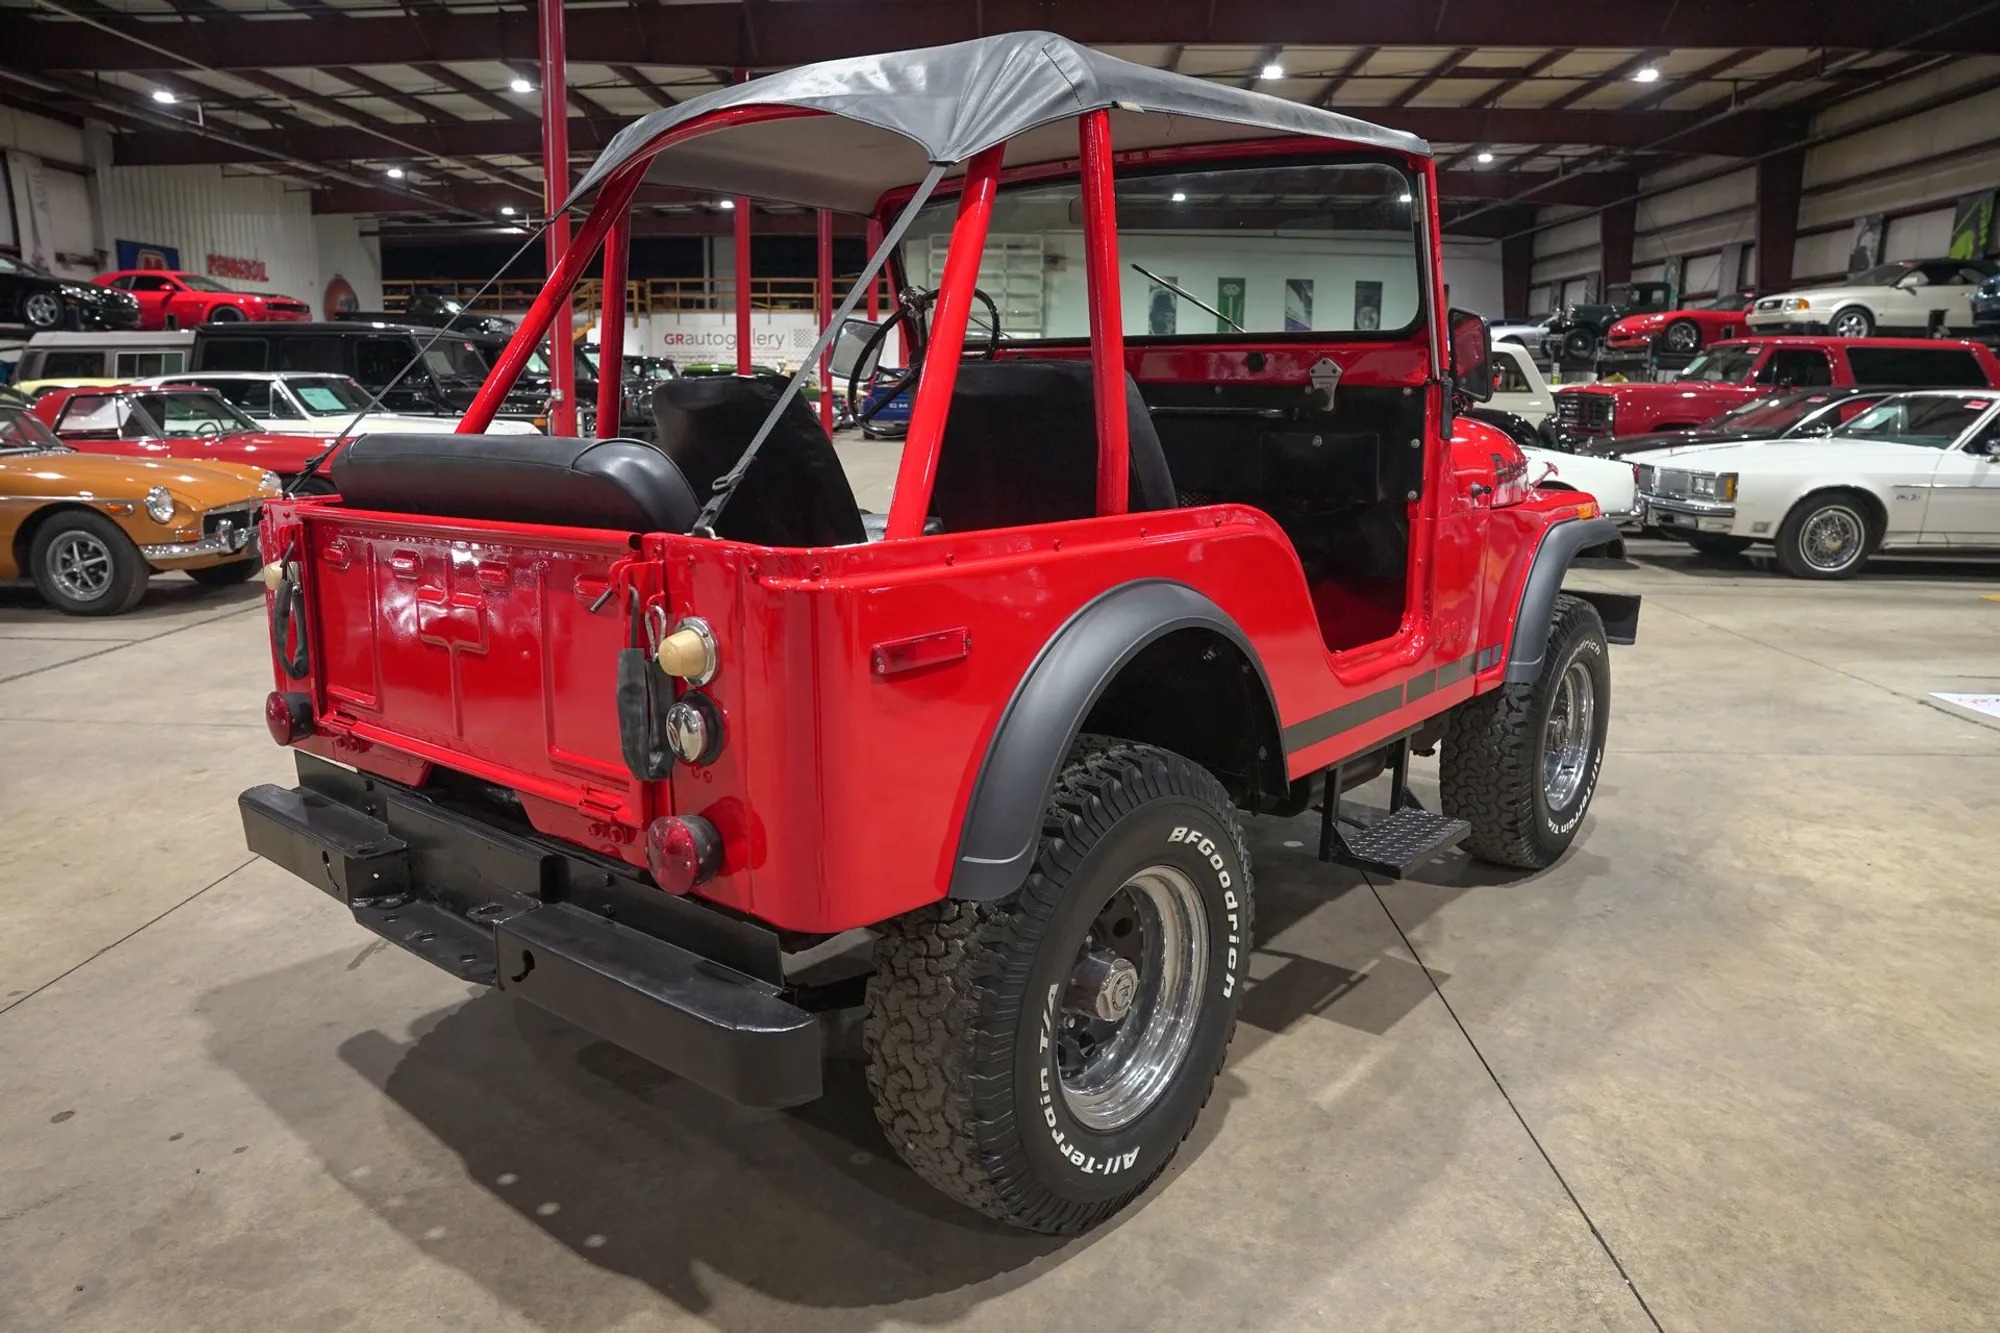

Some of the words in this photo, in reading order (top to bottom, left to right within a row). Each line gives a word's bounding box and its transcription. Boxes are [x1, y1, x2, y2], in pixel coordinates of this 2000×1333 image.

[664, 328, 785, 350] GRautoglery
[1167, 827, 1242, 999] BFGoodrich
[1039, 983, 1060, 1054] T/A
[1039, 1067, 1141, 1175] All-Terrain
